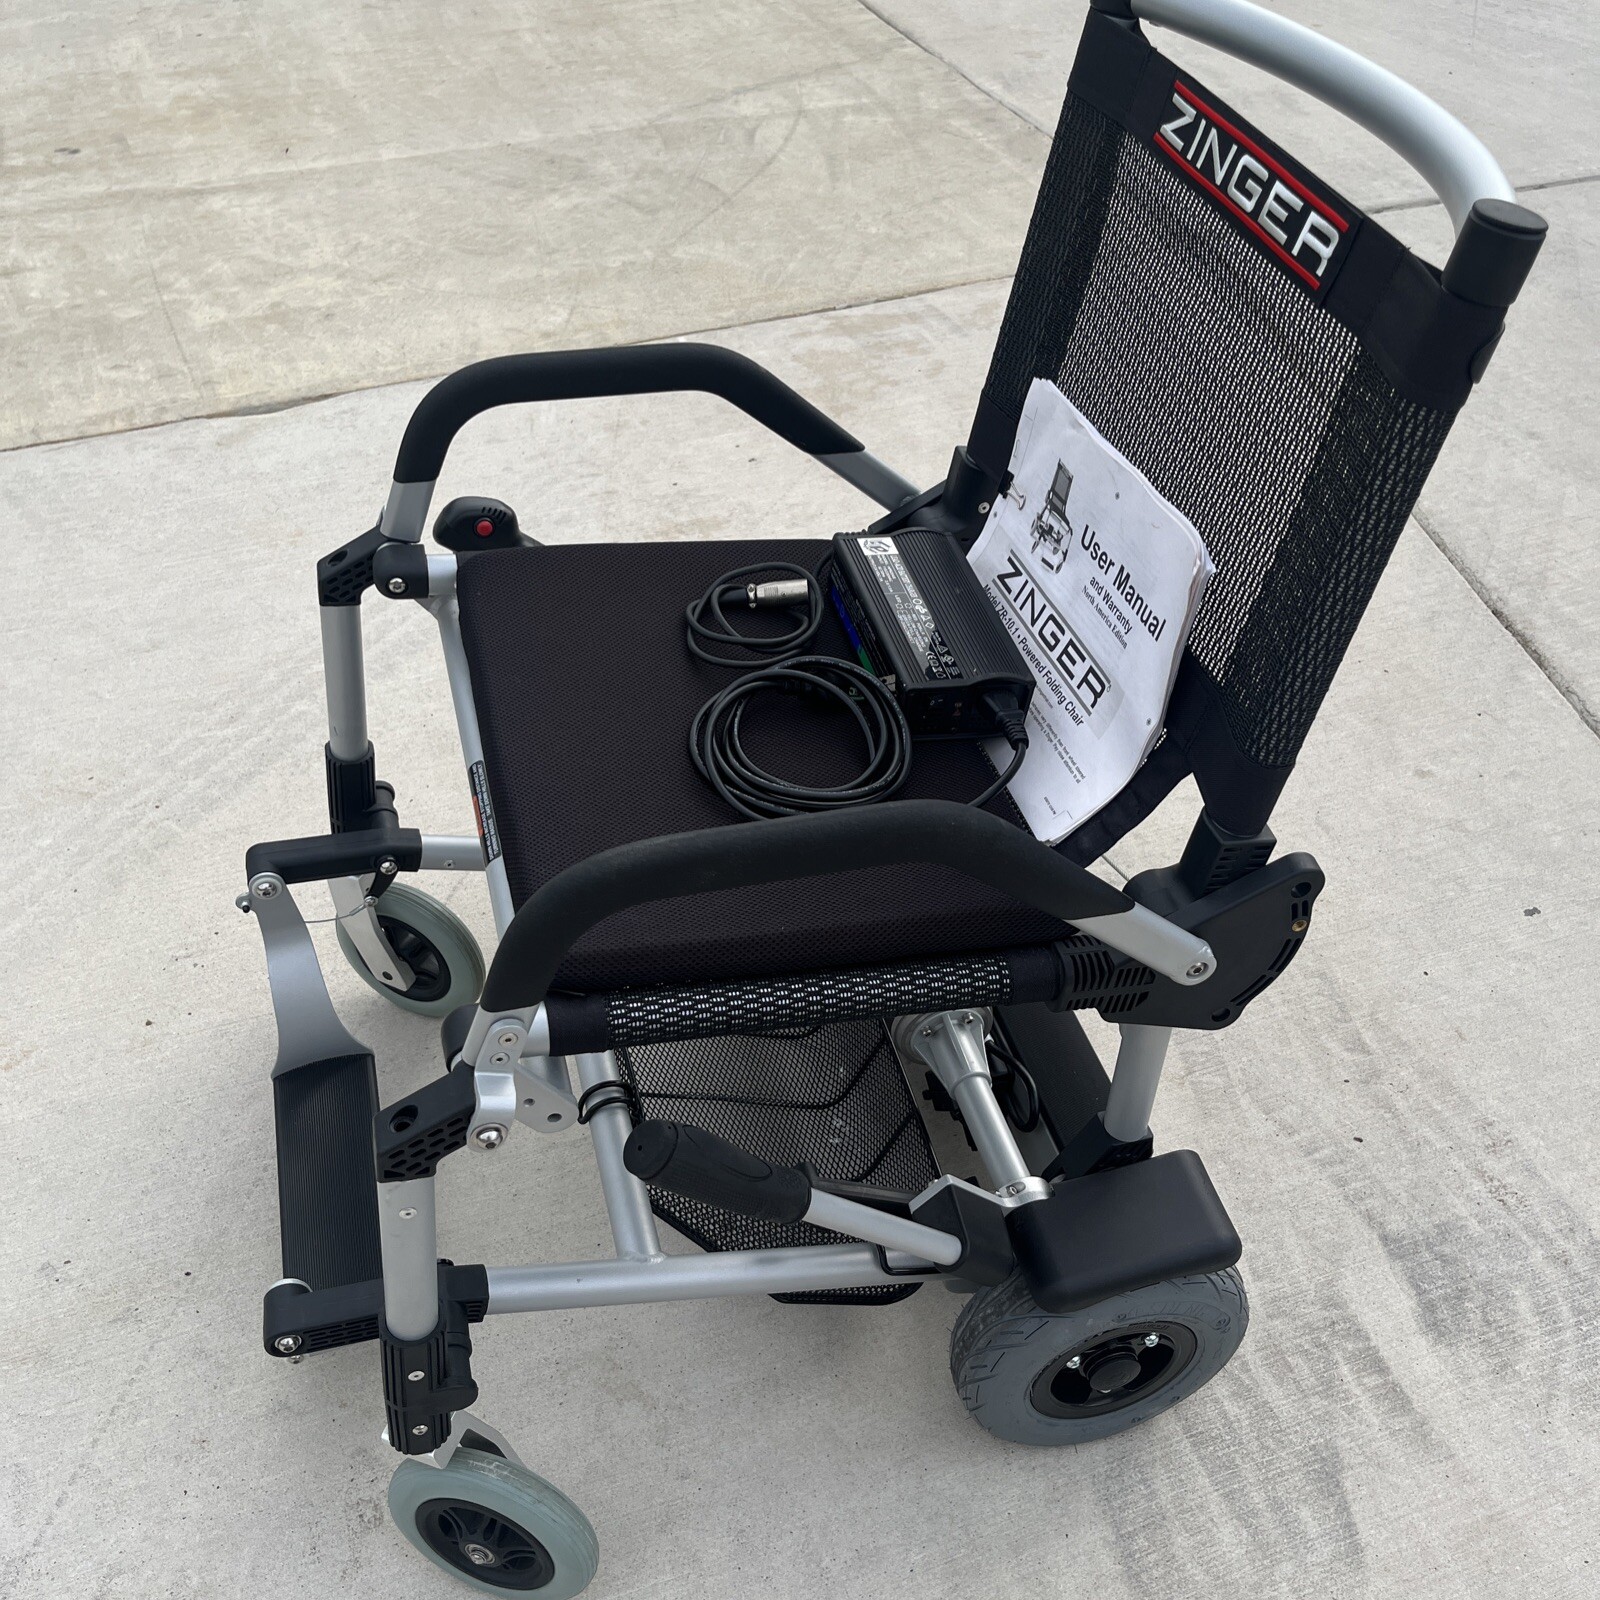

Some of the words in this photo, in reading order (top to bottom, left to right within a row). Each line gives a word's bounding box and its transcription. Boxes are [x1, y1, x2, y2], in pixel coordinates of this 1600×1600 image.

[1160, 92, 1339, 277] ZINGER
[996, 556, 1106, 709] ZINGER
[1081, 524, 1115, 575] User
[1113, 564, 1166, 642] Manual
[1082, 585, 1095, 605] North
[1094, 603, 1113, 628] America
[1111, 624, 1128, 649] Edition
[1089, 577, 1104, 596] and
[1102, 589, 1133, 635] Warranty
[984, 584, 1001, 609] Model
[997, 605, 1020, 636] ZR-10.1
[1017, 637, 1047, 674] Powered
[1042, 669, 1067, 706] Folding
[1064, 701, 1084, 726] Chair
